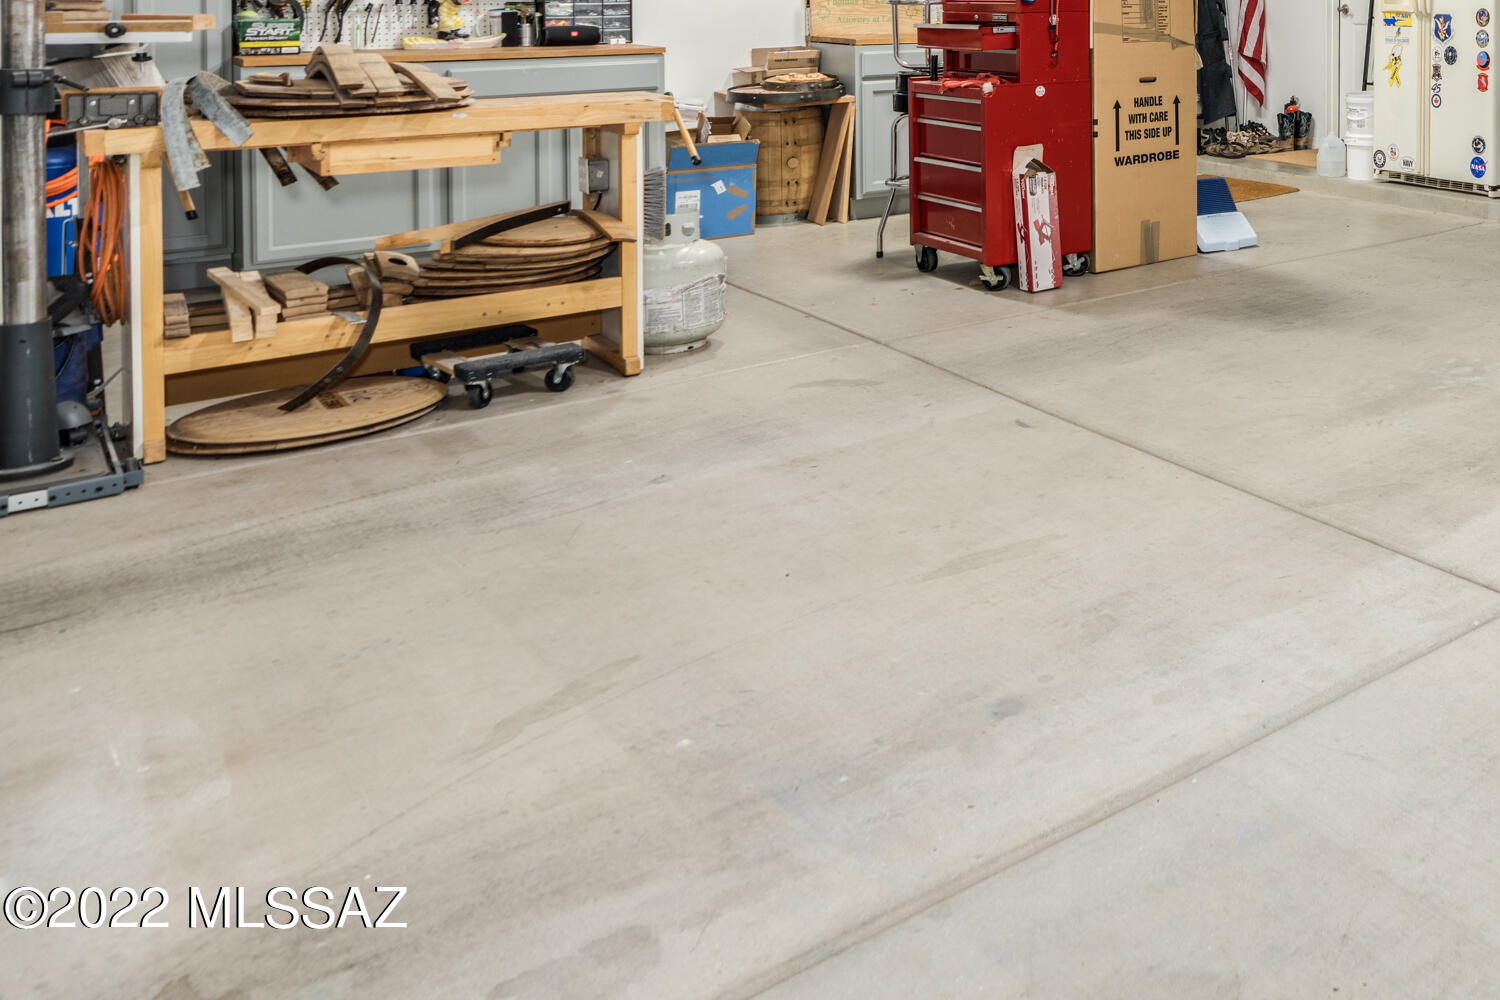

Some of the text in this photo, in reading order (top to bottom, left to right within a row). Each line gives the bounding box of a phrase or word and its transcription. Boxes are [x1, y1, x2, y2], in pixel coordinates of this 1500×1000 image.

[245, 28, 295, 36] START
[1133, 95, 1163, 108] HANDLE
[1128, 110, 1169, 124] WITH CARE
[1124, 126, 1173, 141] THIS SIDE UP
[1114, 149, 1180, 167] WARDROBE
[1470, 163, 1486, 171] NASA
